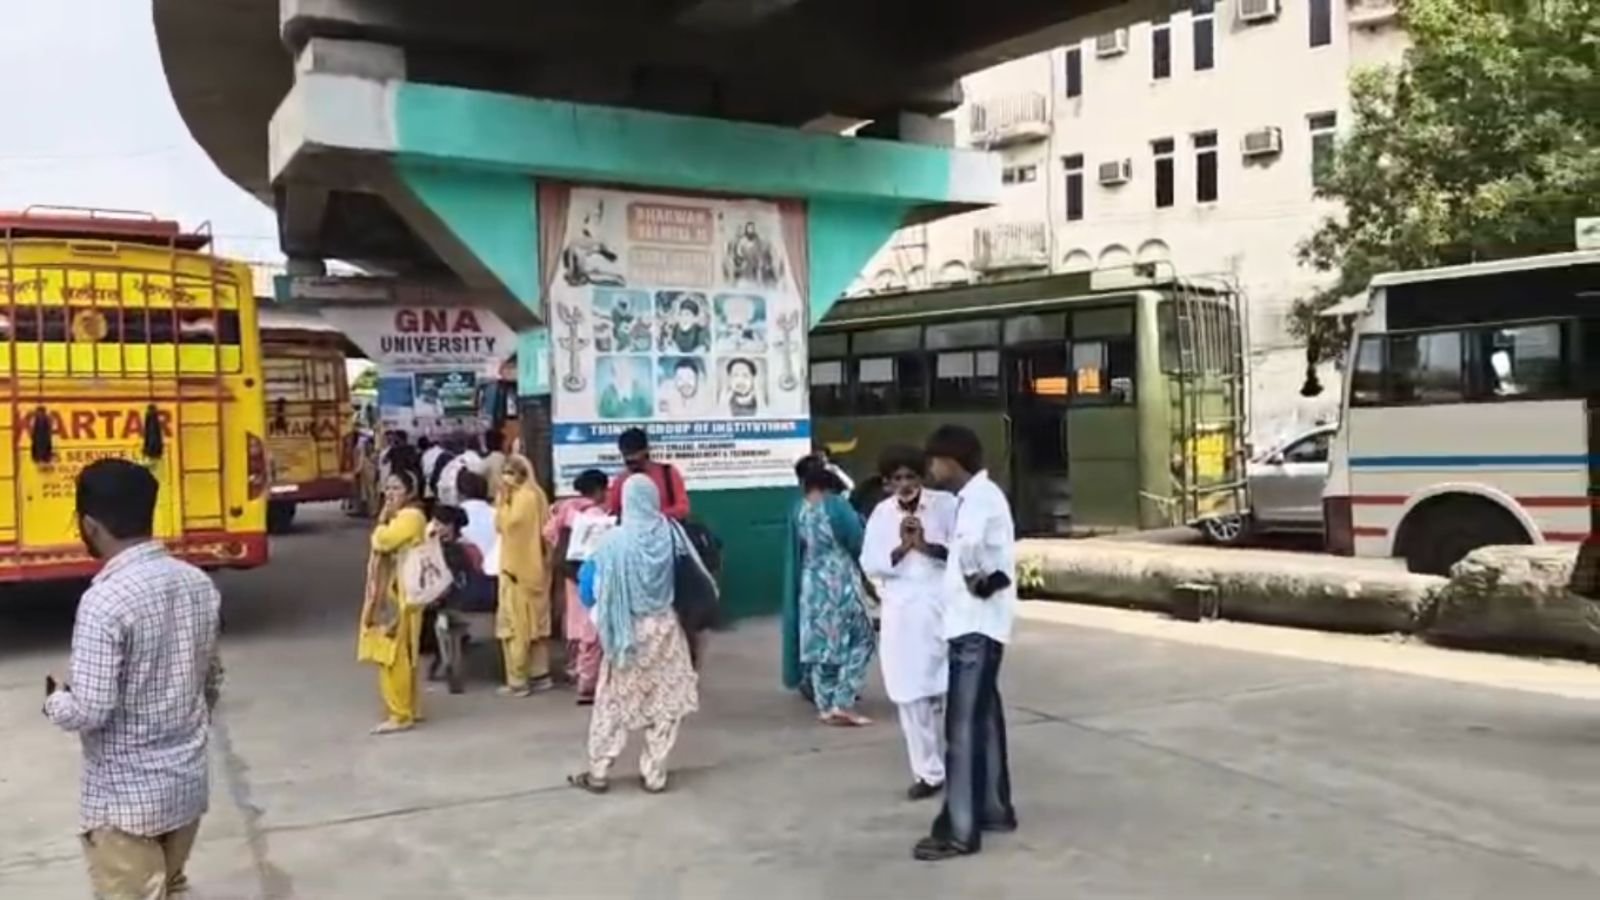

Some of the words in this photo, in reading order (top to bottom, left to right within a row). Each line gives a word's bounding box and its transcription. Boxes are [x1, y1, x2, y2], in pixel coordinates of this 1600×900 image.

[395, 309, 482, 333] GNA
[381, 336, 496, 353] UNIVERSITY
[647, 423, 690, 435] GROUP
[693, 423, 708, 434] OF
[712, 421, 797, 433] INSTITUTIONS
